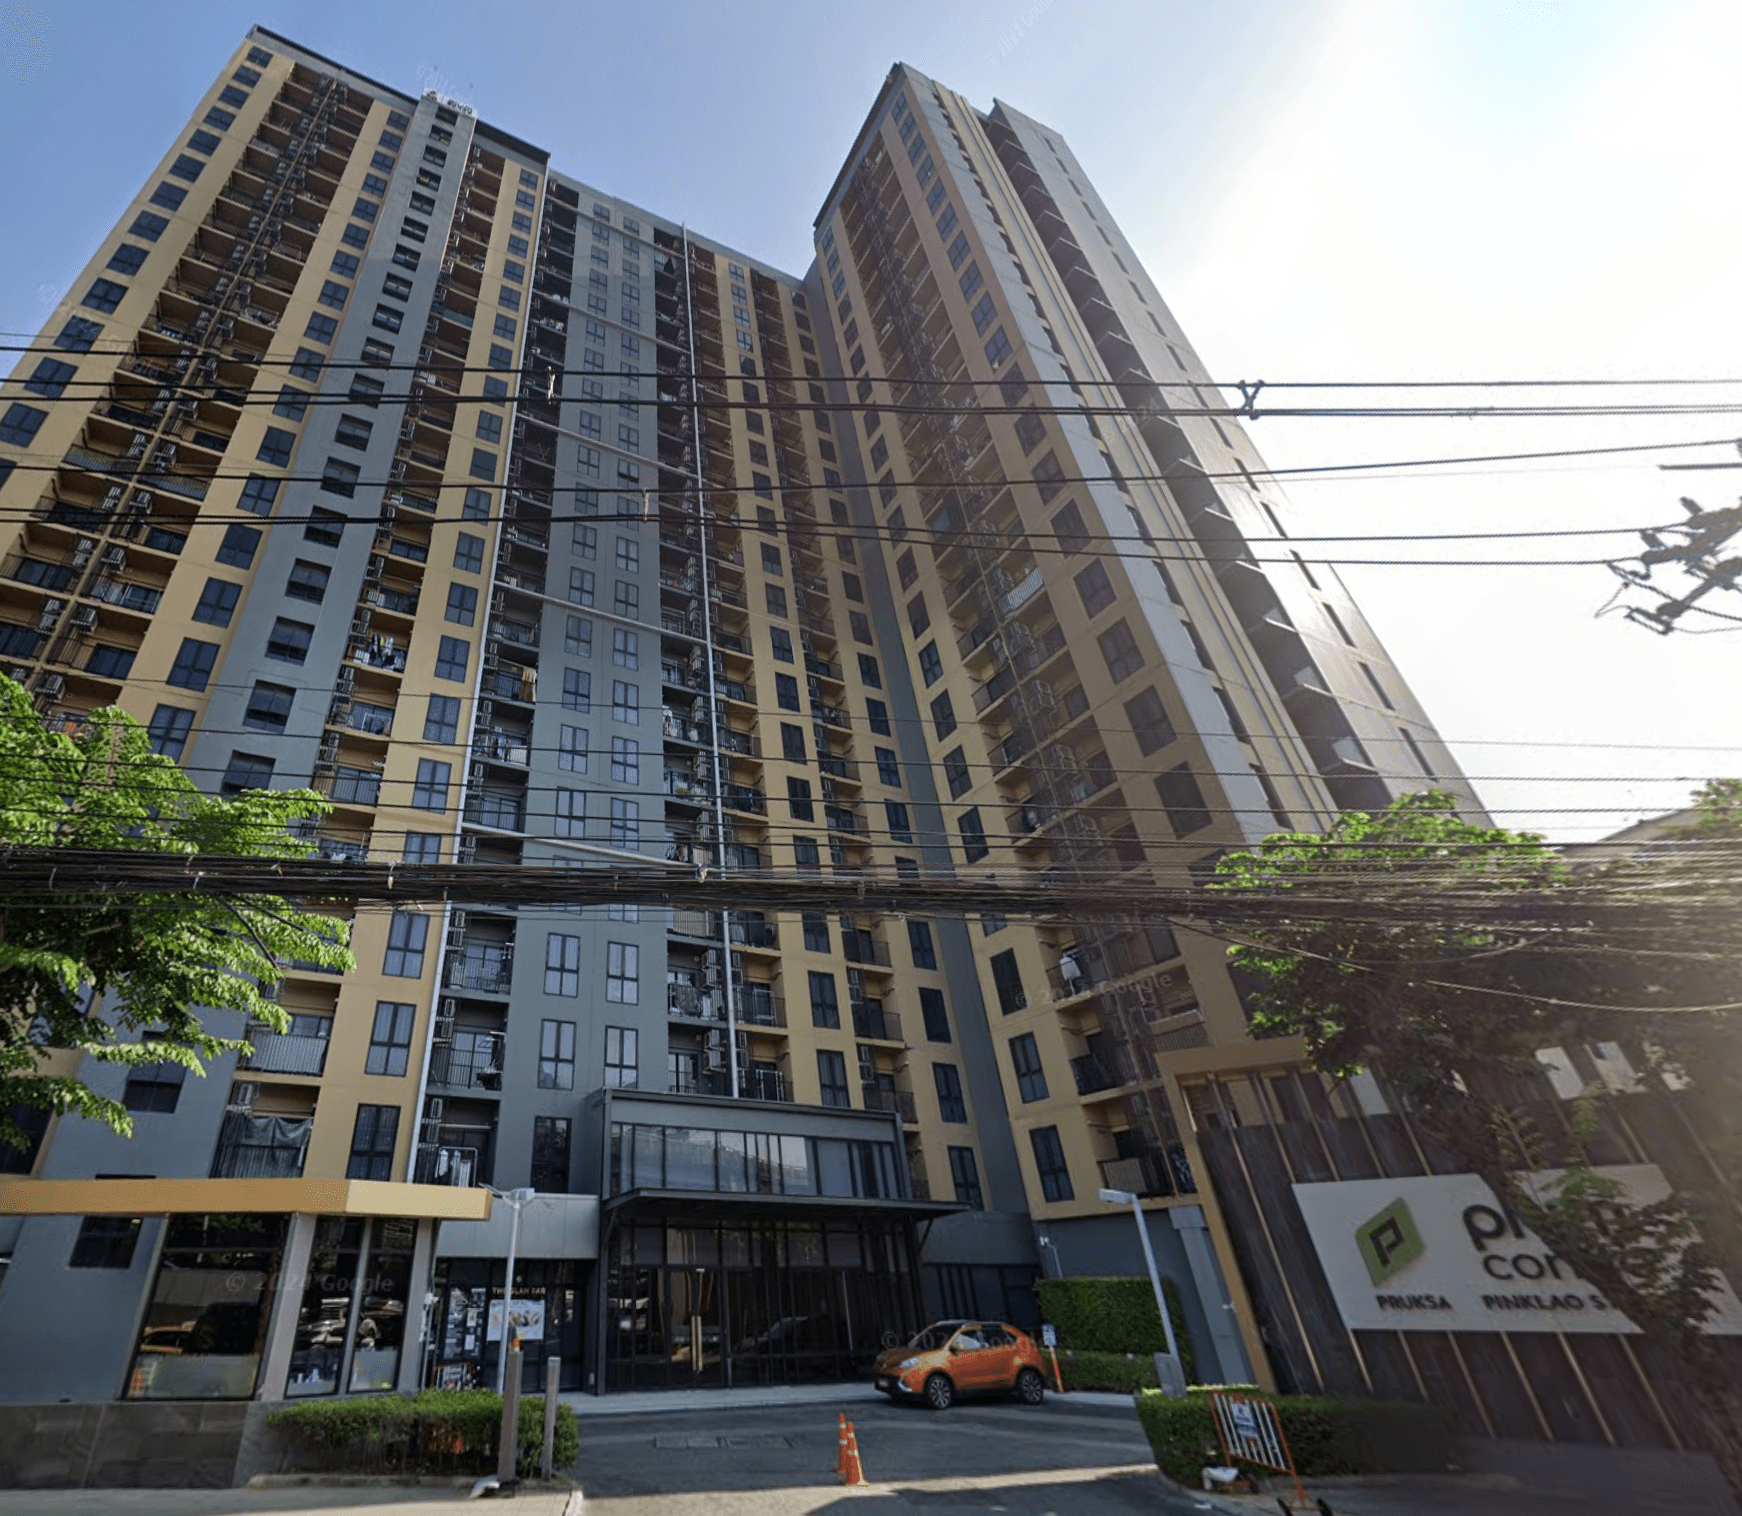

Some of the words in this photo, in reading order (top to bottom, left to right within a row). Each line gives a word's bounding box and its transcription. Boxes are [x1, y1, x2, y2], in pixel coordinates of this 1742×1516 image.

[1462, 1204, 1525, 1251] pl
[1376, 1295, 1453, 1311] PRUKSA
[1481, 1294, 1585, 1311] PINKLAO
